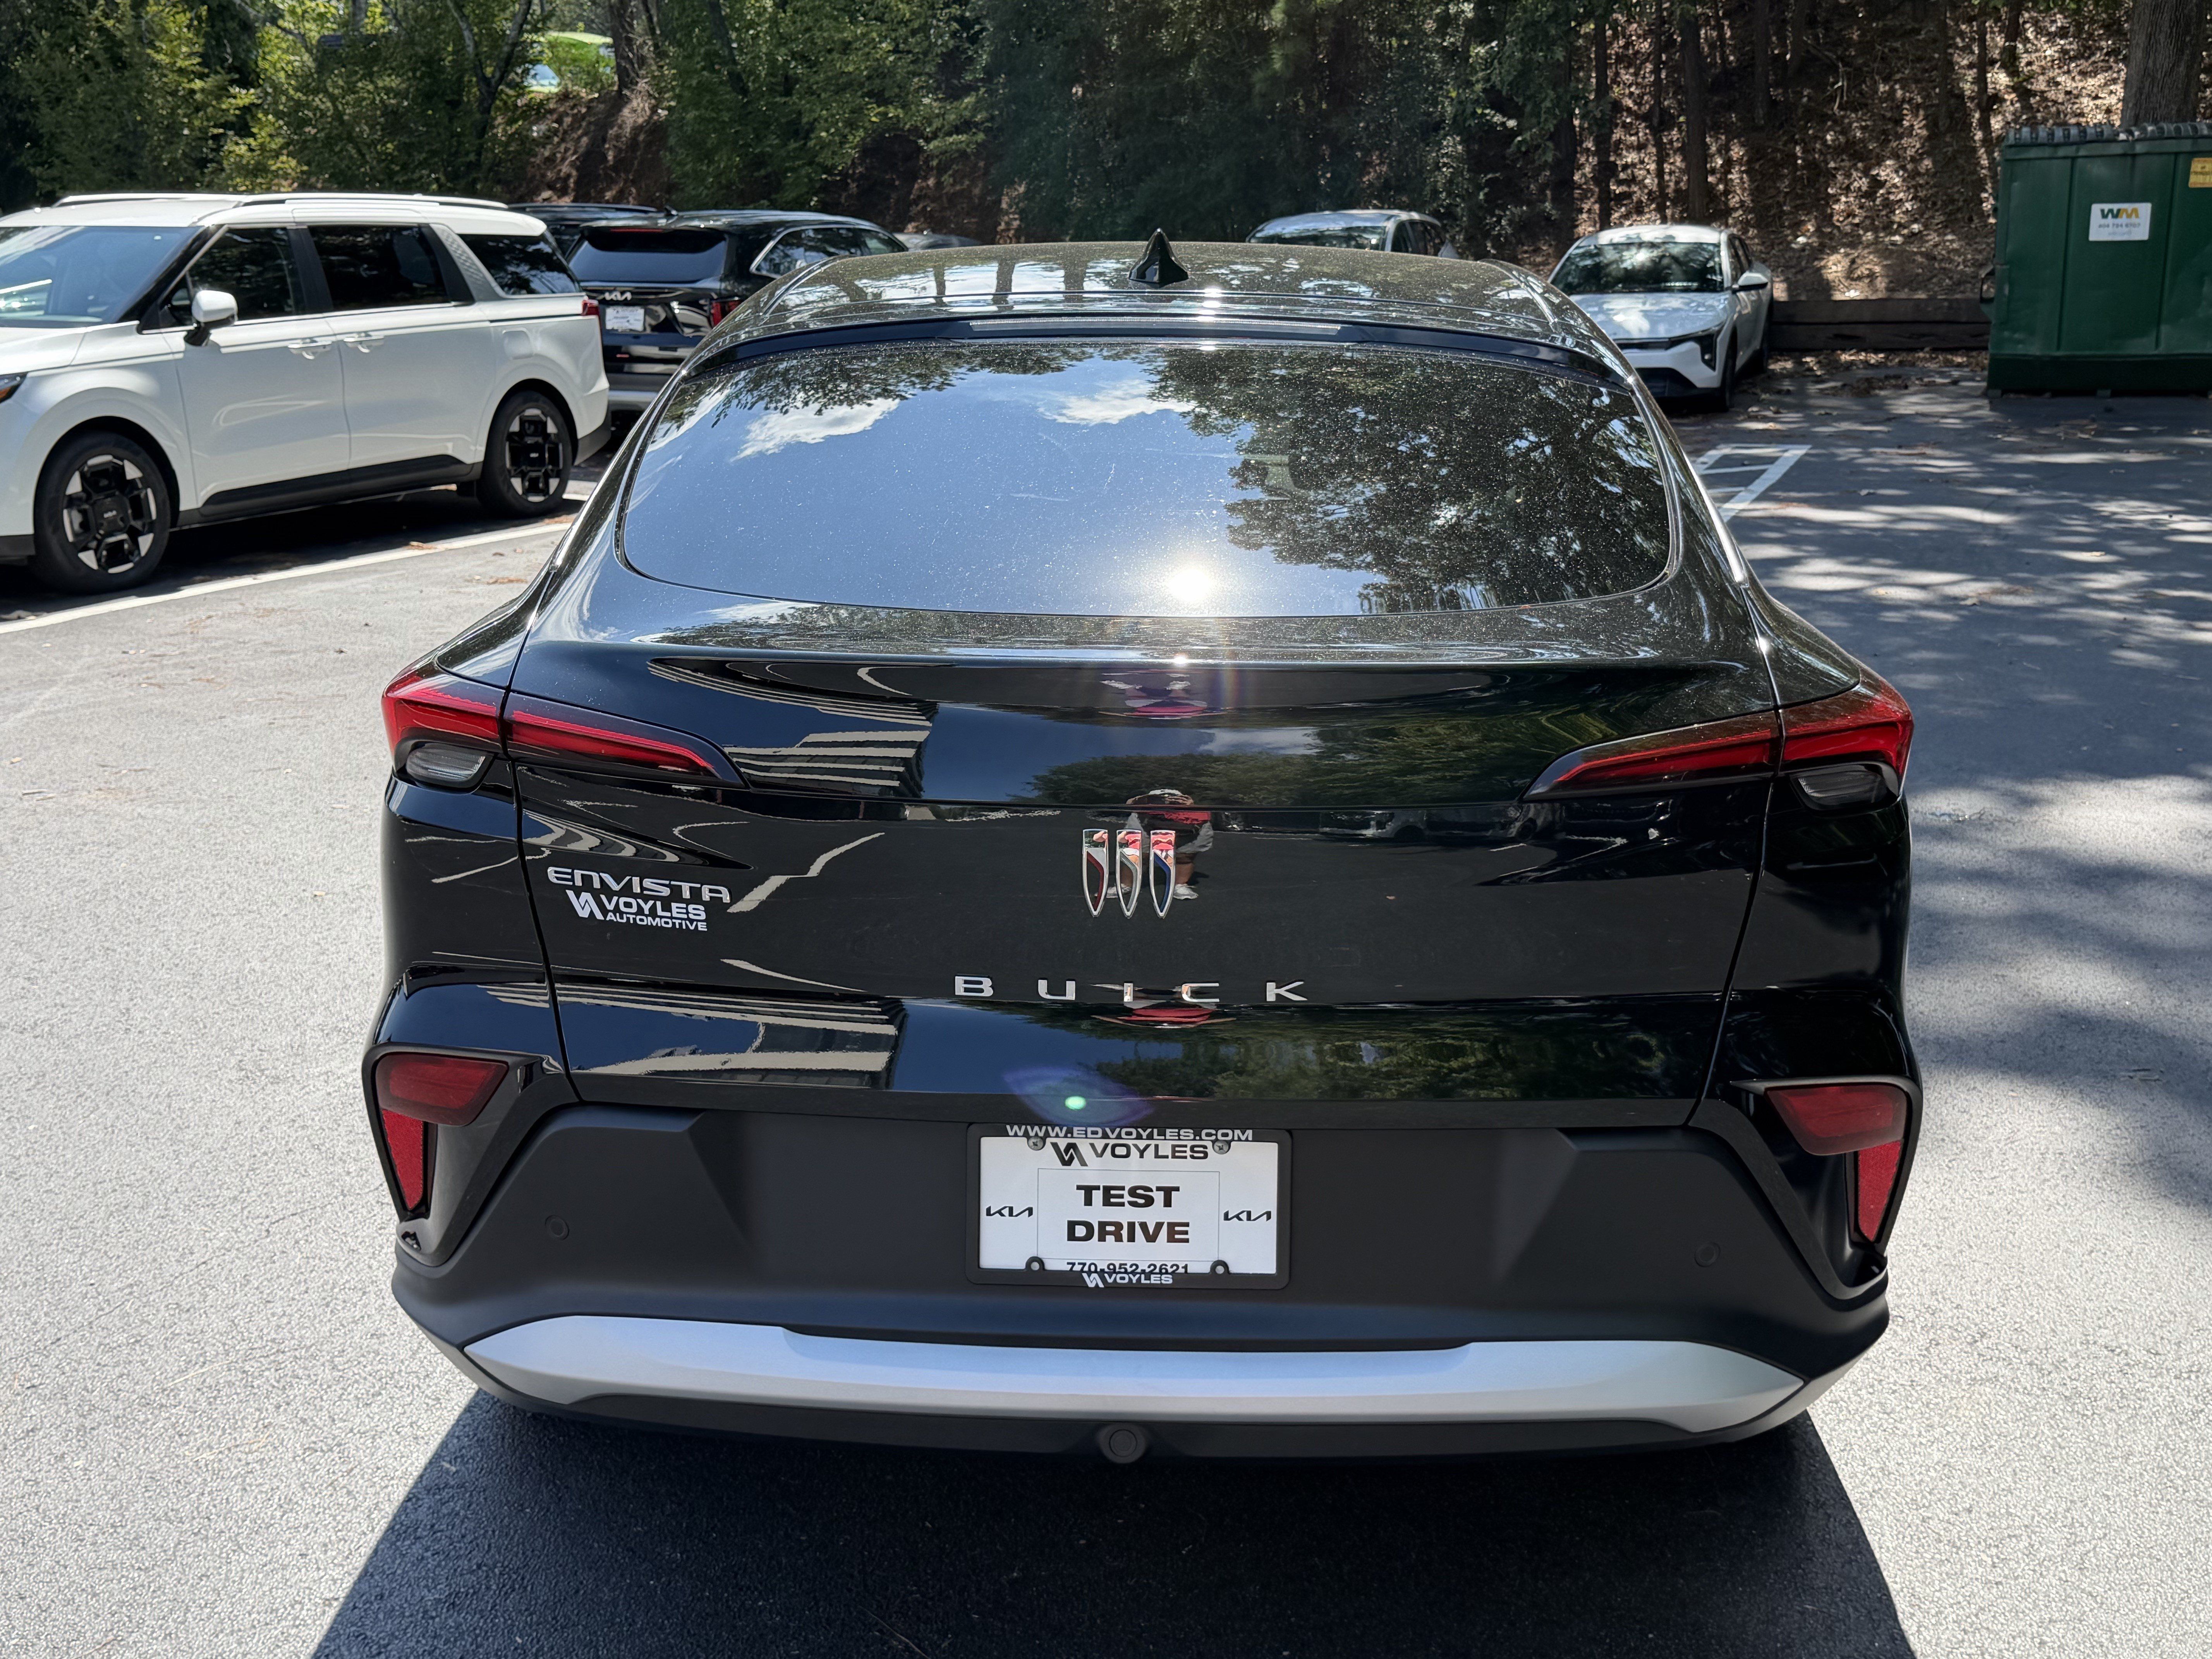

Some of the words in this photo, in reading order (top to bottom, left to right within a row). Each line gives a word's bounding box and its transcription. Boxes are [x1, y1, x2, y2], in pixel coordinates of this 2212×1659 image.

[2100, 207, 2139, 219] WM
[547, 866, 731, 903] ENVISTA
[600, 894, 706, 920] VOYLES
[606, 912, 708, 931] AUTOMOTIVE
[955, 975, 1309, 1002] BUICK
[1006, 1124, 1253, 1141] WWW.EDVOYLES.COM
[1089, 1142, 1209, 1159] VOYLES
[1076, 1184, 1180, 1208] TEST
[986, 1205, 1033, 1218] KIA
[1223, 1210, 1272, 1222] KIA
[1066, 1220, 1190, 1243] DRIVE
[1066, 1261, 1188, 1274] 770-952-2621
[1104, 1273, 1173, 1284] VOYLES
